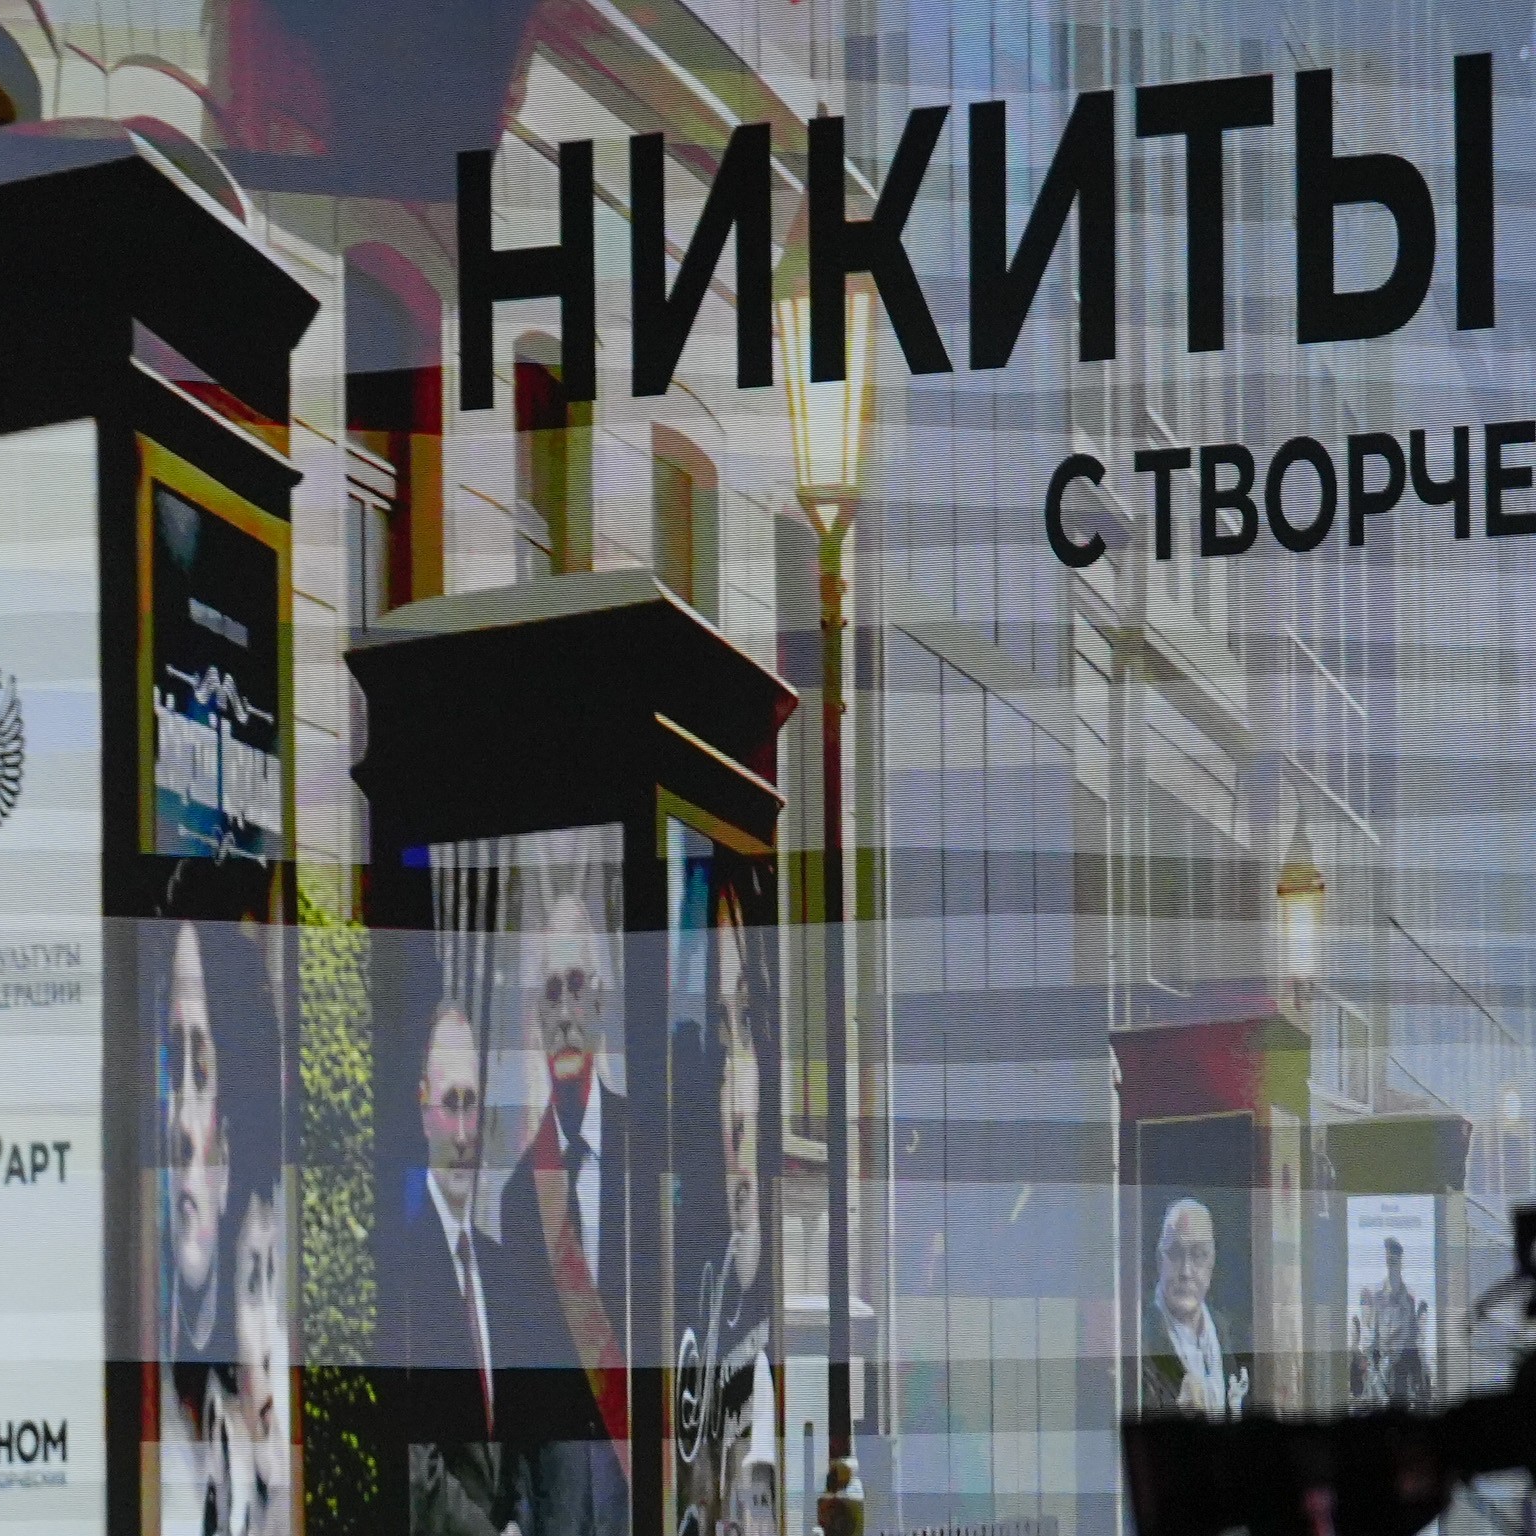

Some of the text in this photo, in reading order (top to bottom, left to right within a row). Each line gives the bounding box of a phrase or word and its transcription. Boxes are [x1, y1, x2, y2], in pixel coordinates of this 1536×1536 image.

[457, 53, 1494, 411] НИКИТЫ
[1045, 420, 1536, 568] С ТВОРЧЕ
